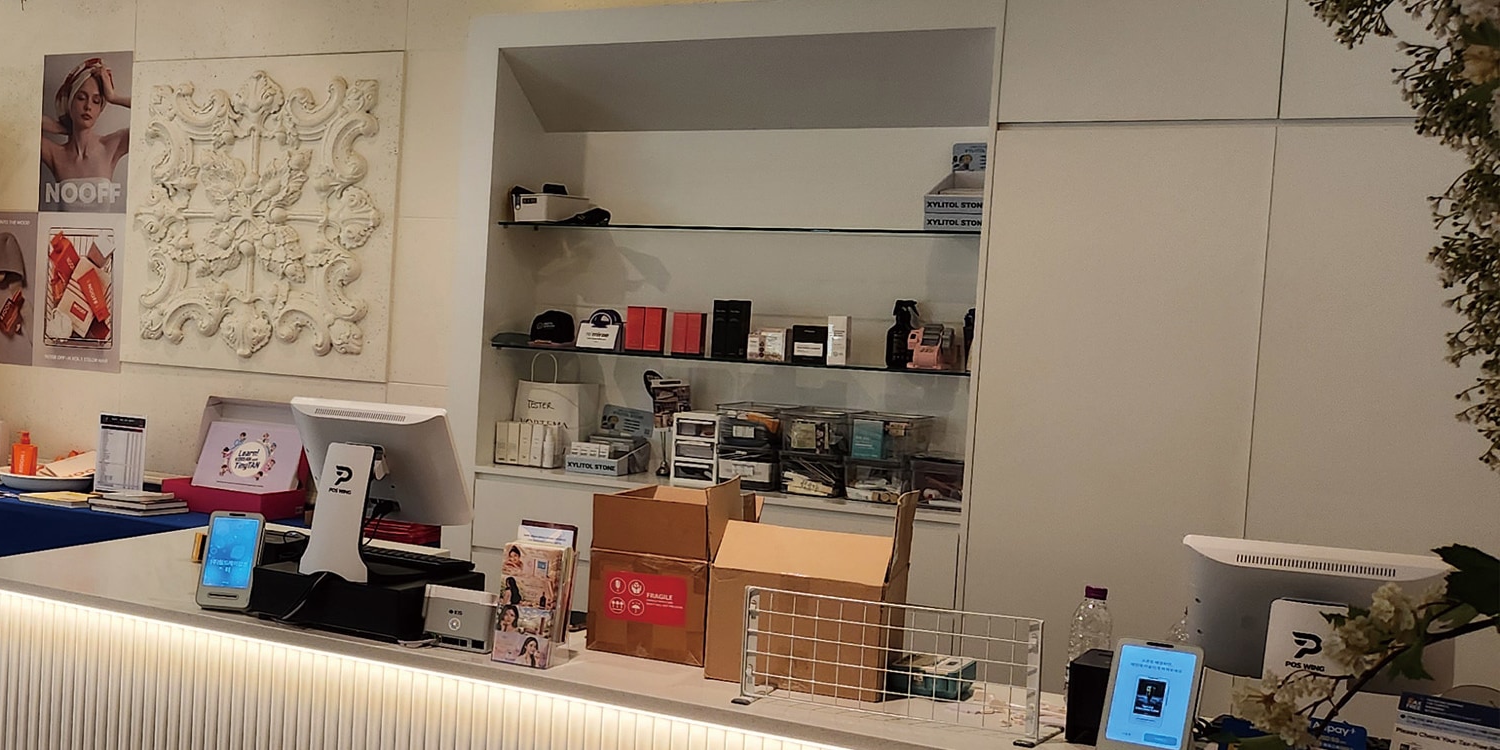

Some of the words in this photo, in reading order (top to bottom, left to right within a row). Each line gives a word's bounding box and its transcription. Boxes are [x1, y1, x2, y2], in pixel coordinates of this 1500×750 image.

[45, 182, 121, 204] NOOFF
[960, 219, 982, 227] STON
[527, 399, 555, 410] TESTER
[567, 462, 593, 470] XYLITOL
[646, 592, 674, 601] FRAGILE
[1285, 661, 1302, 669] POS
[1303, 663, 1326, 672] WING
[1396, 727, 1418, 736] Please
[1419, 731, 1440, 740] Check
